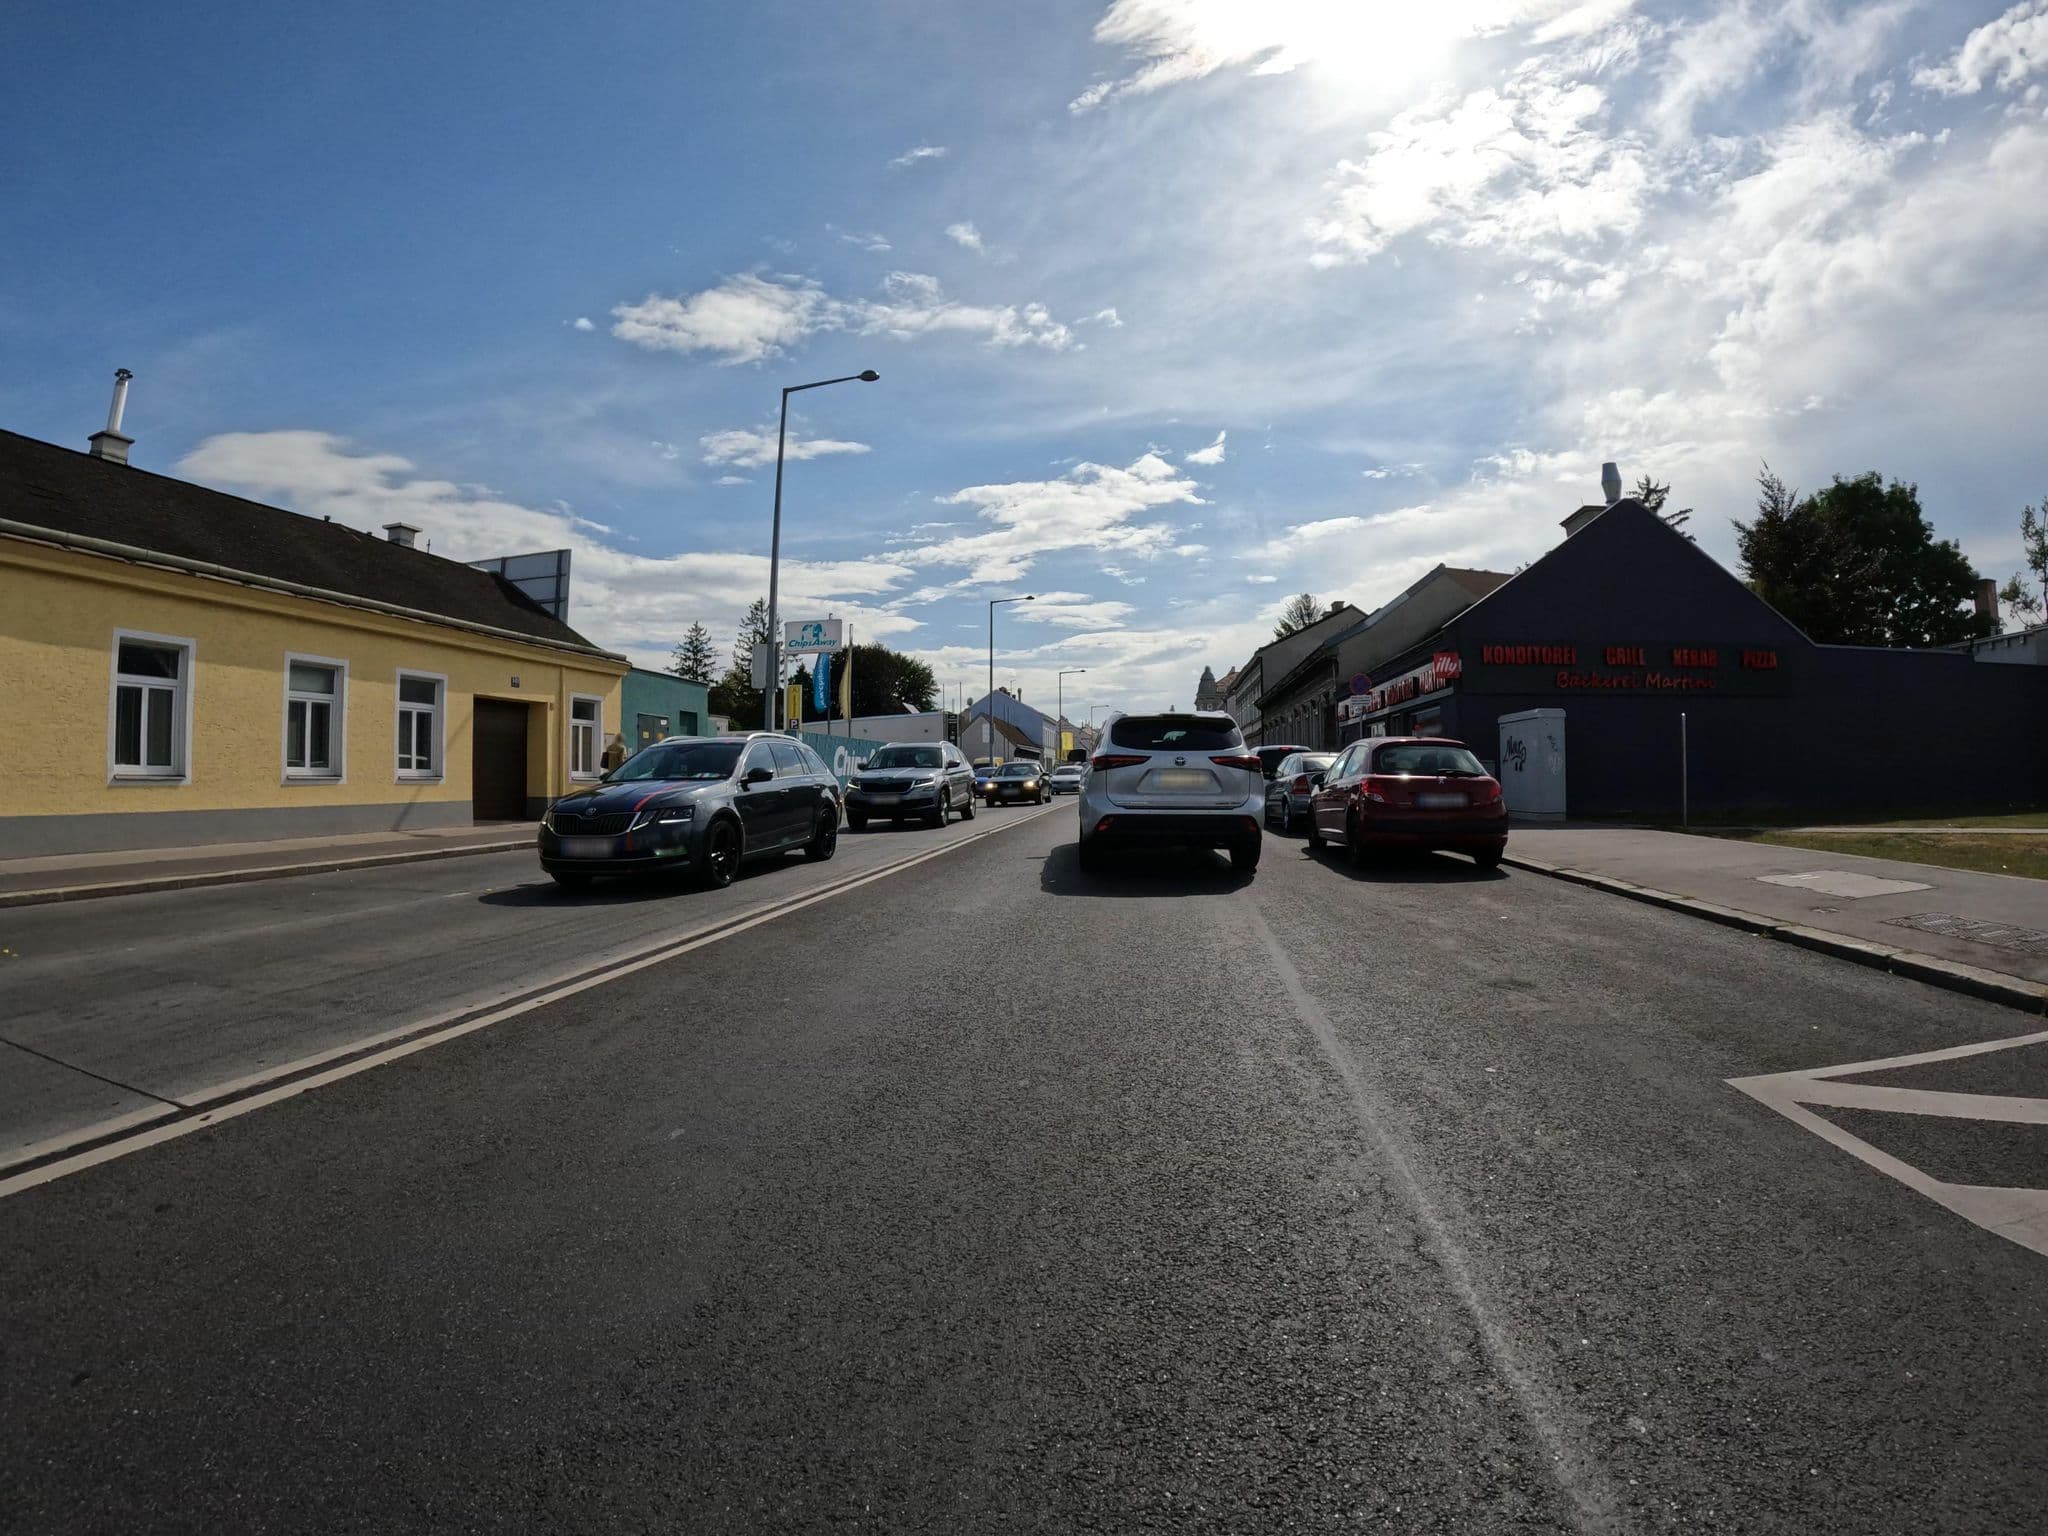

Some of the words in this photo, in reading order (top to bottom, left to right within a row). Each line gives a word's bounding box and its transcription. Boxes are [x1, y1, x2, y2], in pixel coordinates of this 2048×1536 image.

[788, 638, 837, 648] ChipsAway
[1436, 656, 1457, 676] illy
[1482, 645, 1577, 665] KONDITOREI
[1606, 647, 1646, 666] GRILL
[1742, 649, 1777, 669] PIZZA
